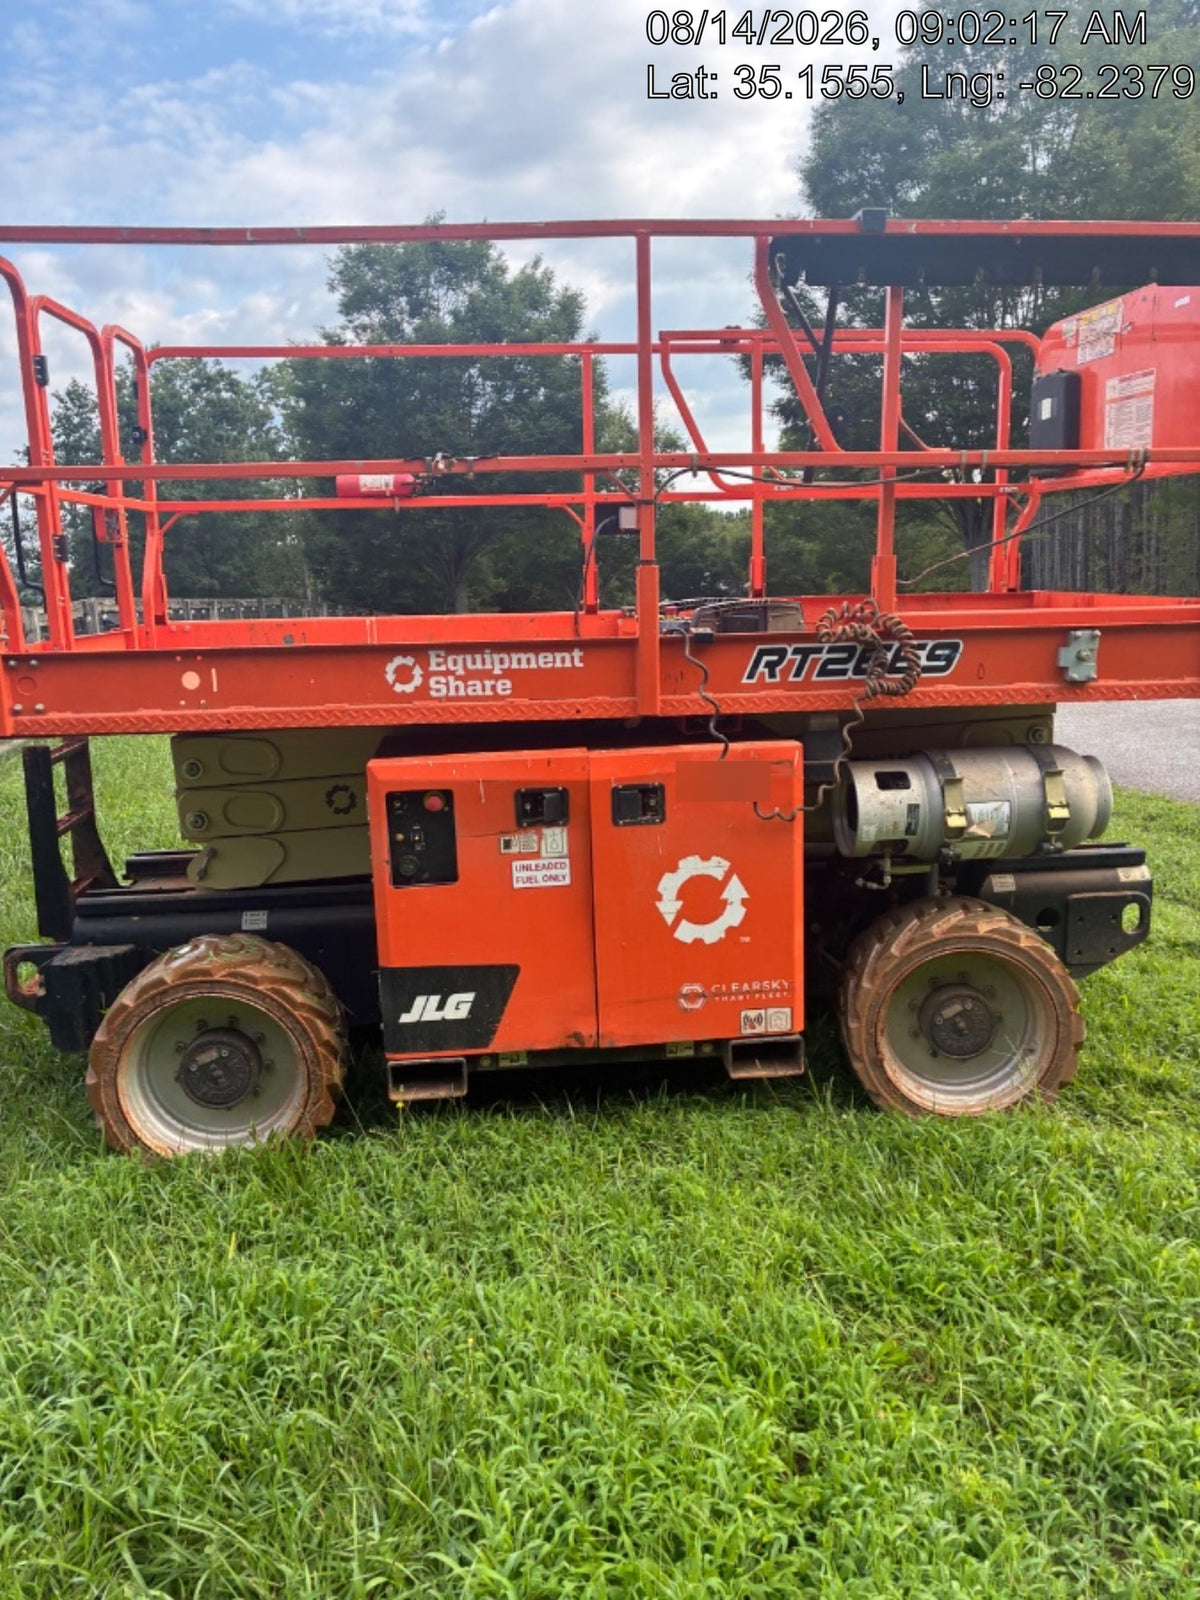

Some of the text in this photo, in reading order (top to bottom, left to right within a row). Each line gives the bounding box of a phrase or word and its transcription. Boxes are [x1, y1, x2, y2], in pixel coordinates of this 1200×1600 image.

[428, 648, 584, 675] Equipment
[429, 676, 513, 698] Share
[515, 862, 567, 873] UNLEADED
[515, 873, 567, 884] FUEL ONLY
[398, 991, 476, 1023] JLG
